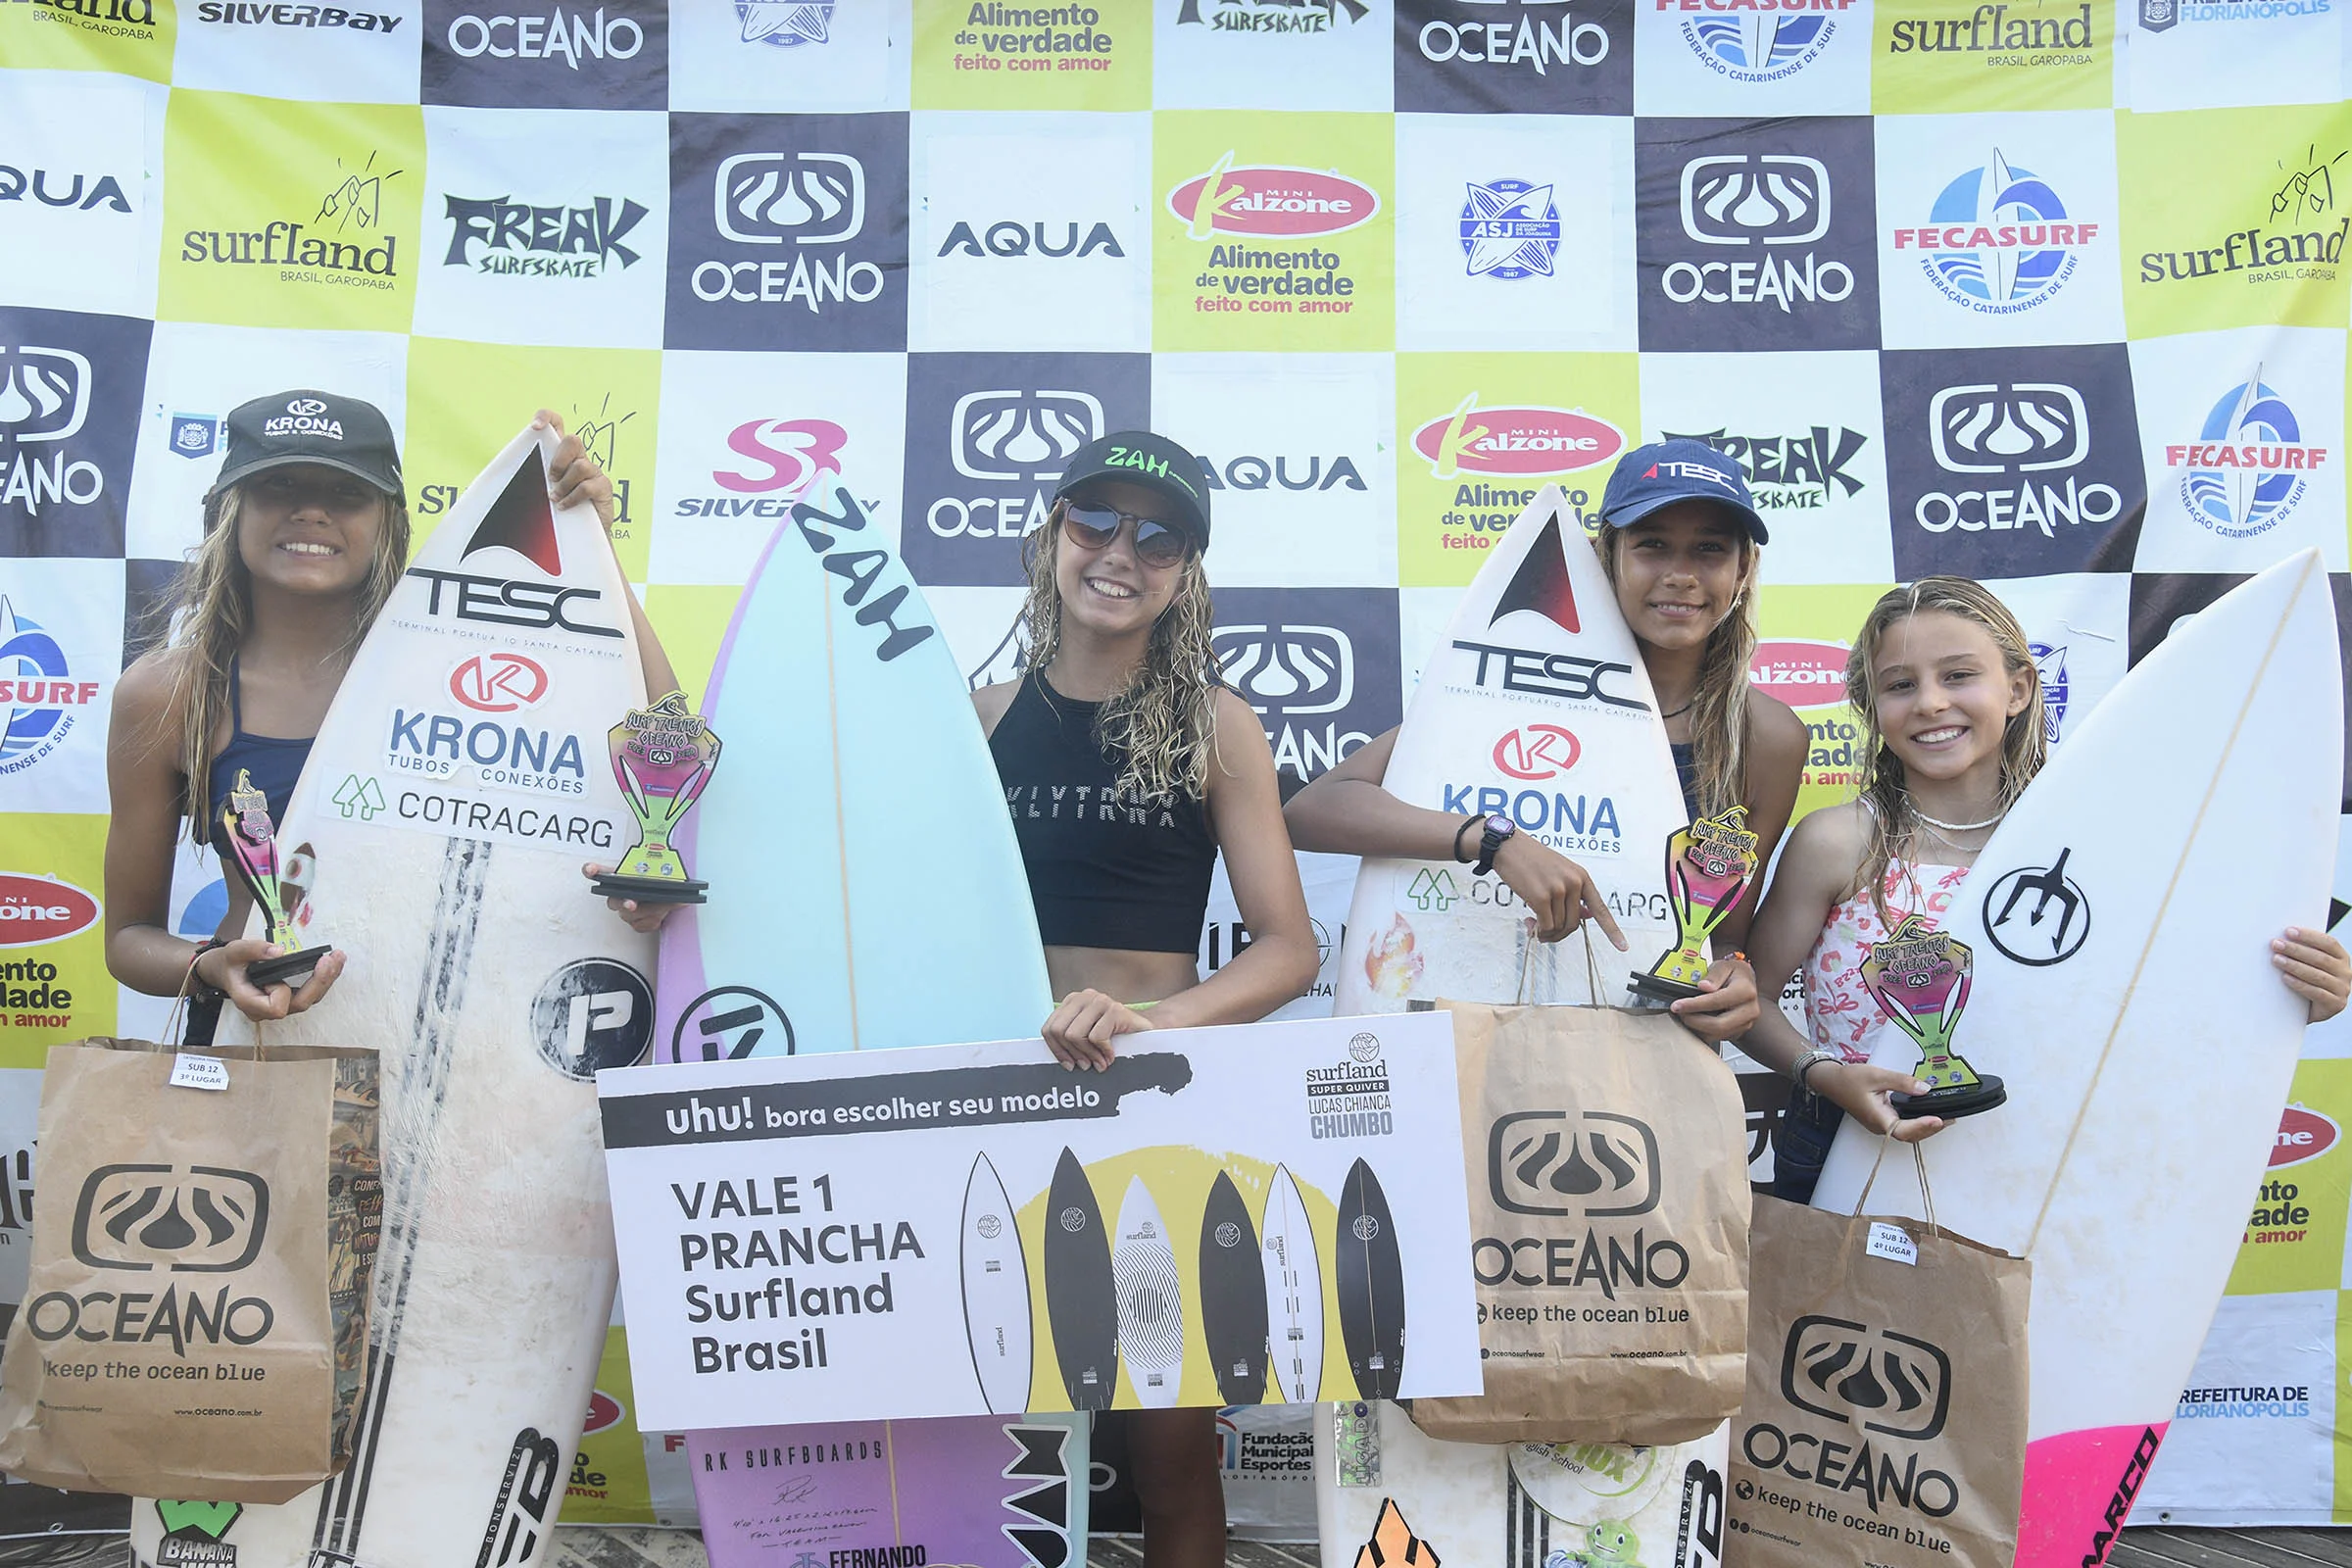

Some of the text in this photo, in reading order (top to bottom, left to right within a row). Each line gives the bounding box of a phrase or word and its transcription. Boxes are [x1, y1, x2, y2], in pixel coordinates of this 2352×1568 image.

[33, 11, 77, 27] BRASIL,
[81, 21, 154, 40] GAROPABA
[968, 3, 1100, 26] Alimento
[1212, 11, 1327, 33] SURFSKATE
[1890, 4, 2092, 53] surfland
[448, 6, 643, 71] OCEANO
[955, 27, 1112, 55] de verdade
[1419, 13, 1609, 76] OCEANO
[1729, 60, 1803, 83] CATARINENSE
[1803, 48, 1819, 65] DE
[1817, 20, 1838, 49] SURF
[954, 54, 1111, 73] feito com amor
[2031, 54, 2093, 67] GAROPABA
[1193, 164, 1351, 237] Kalzone
[443, 193, 649, 273] FREAK
[937, 221, 1125, 257] AQUA
[1470, 221, 1513, 238] ASJ
[1894, 223, 2098, 250] FECASURF
[181, 221, 396, 276] surfland
[1208, 245, 1341, 270] Alimento
[2140, 218, 2351, 284] surfland
[280, 270, 395, 291] BRASIL, GAROPABA
[478, 255, 598, 278] SURFSKATE
[691, 251, 883, 314] OCEANO
[1196, 270, 1354, 296] de verdade
[1661, 251, 1855, 315] OCEANO
[1920, 255, 2079, 315] FEDERAÇÃO CATARINENSE DE SURF
[1196, 296, 1352, 314] feito com amor
[265, 416, 343, 436] KRONA
[1436, 402, 1598, 477] Kalzone
[1104, 447, 1169, 478] ZAH
[2165, 445, 2327, 469] FECASURF
[1659, 462, 1739, 496] TESC
[1454, 484, 1589, 508] Alimeto
[1916, 476, 2122, 538] OCEANO
[2216, 517, 2278, 539] CATARINENSE
[2278, 505, 2291, 521] DE
[2289, 479, 2308, 507] SURF
[927, 487, 1049, 538] OCEA
[1442, 512, 1465, 525] de
[1442, 534, 1490, 550] feito
[790, 486, 934, 662] ZAH
[406, 567, 625, 639] TESC
[524, 639, 560, 652] SANTA
[565, 645, 624, 661] CATARINA
[1451, 640, 1652, 711] TESC
[1444, 686, 1496, 699] TERMINAL
[1568, 703, 1599, 713] SANTA
[1605, 709, 1655, 723] CATARINA
[38, 714, 75, 759] DE SURF
[390, 709, 585, 780] KRONA
[388, 753, 450, 775] TUBOS
[481, 767, 584, 795] CONEXÕES
[398, 792, 612, 849] COTRACARG
[1444, 783, 1621, 839] KRONA
[15, 1013, 71, 1028] amor
[188, 1063, 206, 1072] SUB
[191, 1075, 221, 1084] LUGAR
[1306, 1058, 1389, 1082] surfland
[1310, 1082, 1386, 1095] SUPER QUIVER
[665, 1086, 1101, 1136] uhu! bora escolher seu modelo
[1308, 1095, 1392, 1114] LUCAS CHIANCA
[1310, 1111, 1394, 1140] CHUMBO
[670, 1173, 834, 1221] VALE 1
[680, 1221, 926, 1272] PRANCHA
[1881, 1232, 1897, 1242] SUB
[1885, 1245, 1911, 1256] LUGAR
[2255, 1230, 2307, 1244] amor
[1472, 1226, 1690, 1301] OCEANO
[687, 1272, 894, 1324] Surfland
[26, 1282, 274, 1358] OCEANO
[1493, 1304, 1690, 1326] keep the ocean blue
[693, 1327, 828, 1374] Brasil
[1492, 1348, 1688, 1359] oceanosurfwear www.oceano.com.br
[47, 1361, 267, 1382] keep the ocean blue
[2282, 1387, 2309, 1401] DE
[174, 1407, 263, 1417] www.oceano.com.br
[2176, 1401, 2310, 1419] LORIANÓPOLIS
[706, 1441, 882, 1471] RK SURFBOARDS
[1240, 1458, 1311, 1472] Esportes
[1241, 1445, 1314, 1460] Municipal
[1551, 1451, 1585, 1476] School
[1743, 1423, 1959, 1517] OCEANO
[485, 1445, 524, 1544] BONSERVIZI
[1758, 1487, 1951, 1554] keep the ocean blue
[166, 1536, 234, 1562] BANANA
[829, 1544, 926, 1568] FERNANDO
